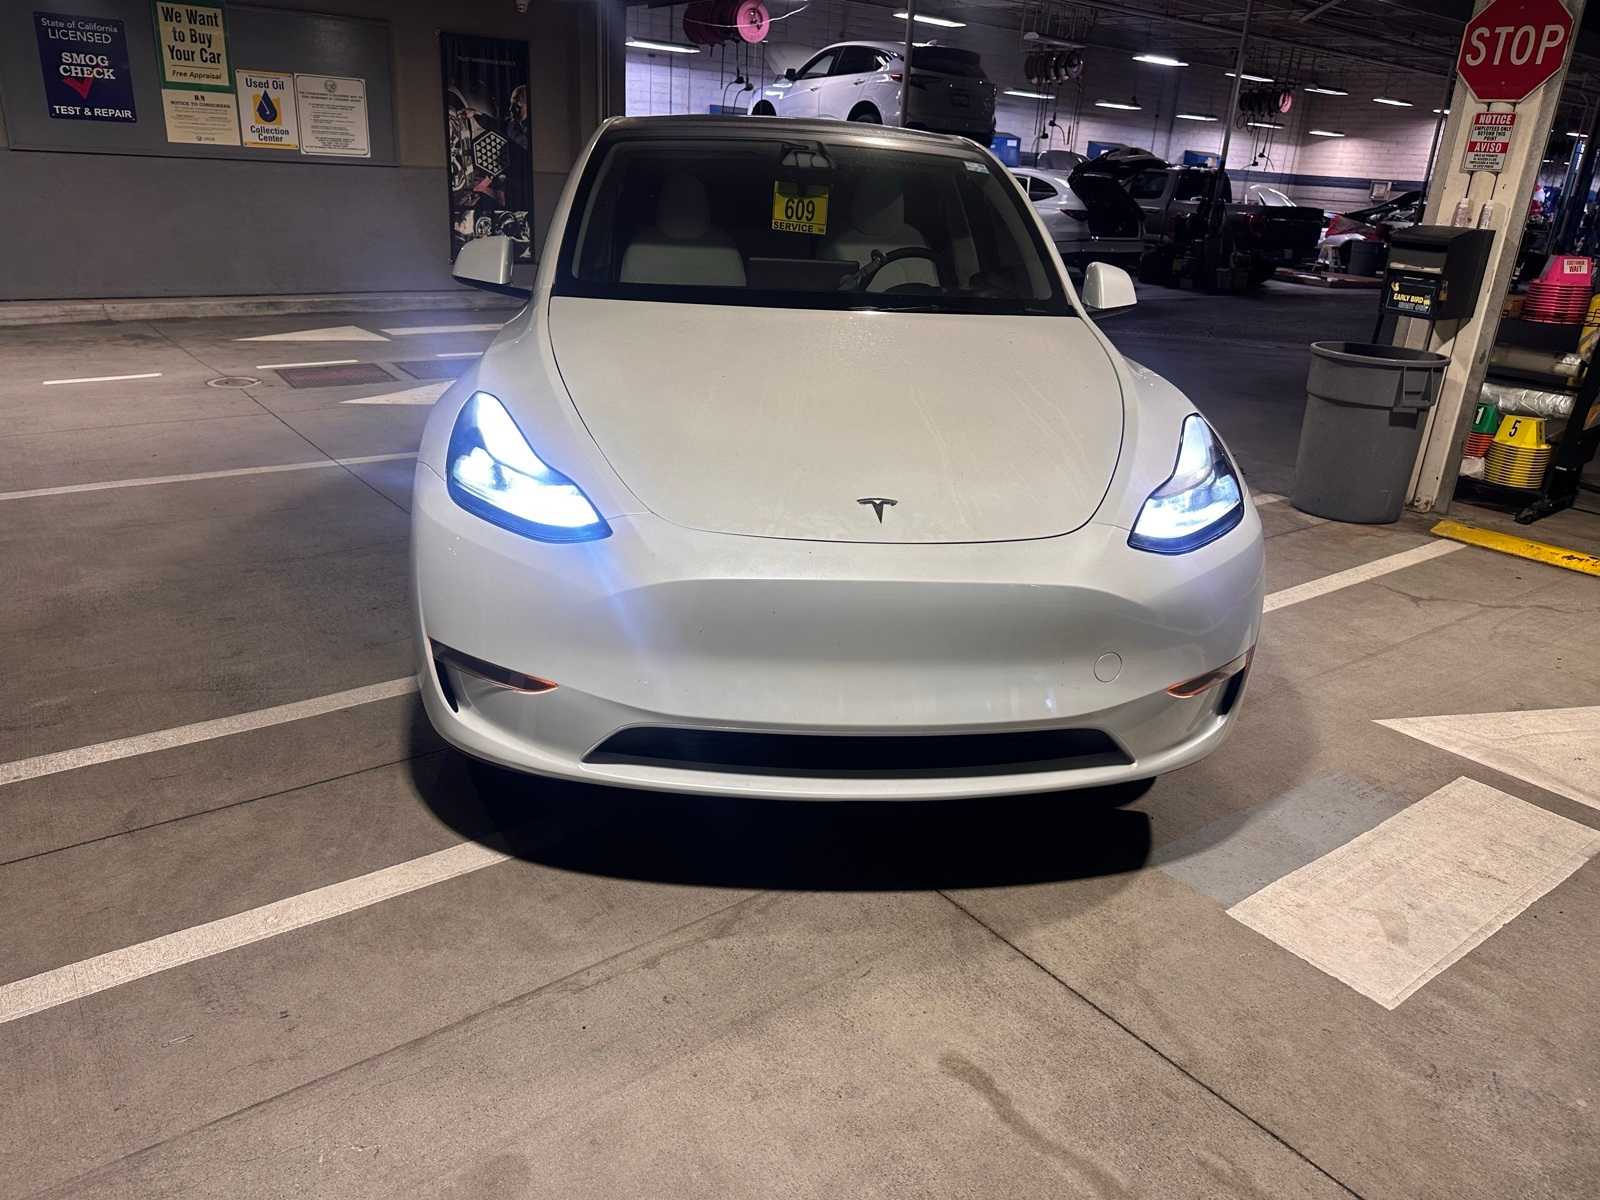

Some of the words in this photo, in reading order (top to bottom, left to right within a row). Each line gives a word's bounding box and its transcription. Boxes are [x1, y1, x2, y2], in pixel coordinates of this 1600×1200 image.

[161, 6, 181, 23] We
[186, 9, 219, 27] Want
[41, 17, 64, 28] State
[67, 20, 75, 29] of
[78, 21, 118, 33] California
[48, 28, 112, 44] LICENSED
[172, 26, 185, 42] to
[189, 28, 212, 48] Buy
[1465, 24, 1565, 66] STOP
[61, 51, 109, 66] SMOG
[168, 45, 195, 62] Your
[199, 47, 221, 64] Car
[59, 65, 116, 79] CHECK
[172, 69, 188, 77] Free
[189, 72, 222, 80] Appraisal
[245, 77, 269, 88] Used
[272, 79, 285, 90] Oil
[53, 105, 81, 115] TEST
[84, 107, 91, 116] &
[94, 108, 133, 118] REPAIR
[1478, 114, 1513, 125] NOTICE
[250, 124, 289, 135] Collection
[258, 133, 283, 142] Center
[1473, 142, 1502, 152] AVISO
[785, 198, 815, 221] 609
[774, 221, 814, 232] SERVICE
[1393, 292, 1410, 302] EARLY
[1410, 295, 1424, 304] BIRD
[1475, 407, 1485, 425] 1
[1509, 419, 1521, 437] 5
